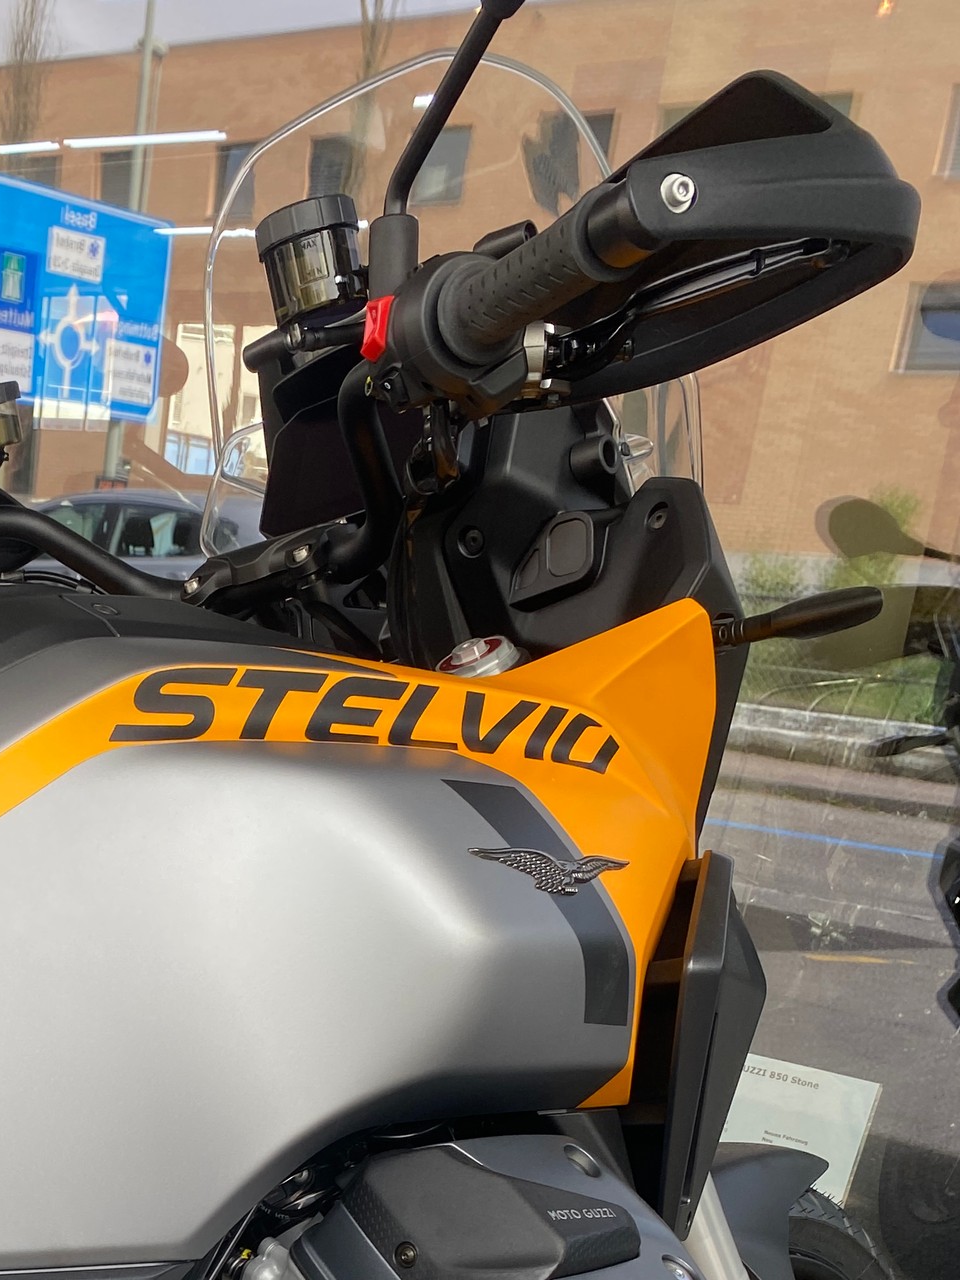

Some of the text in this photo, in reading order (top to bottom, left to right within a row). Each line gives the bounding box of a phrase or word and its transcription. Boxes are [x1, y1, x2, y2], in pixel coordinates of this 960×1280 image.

[109, 666, 620, 774] STELVIO
[742, 1064, 820, 1090] UZZI 850 Stone
[547, 1208, 617, 1221] MOTO GUZZI
